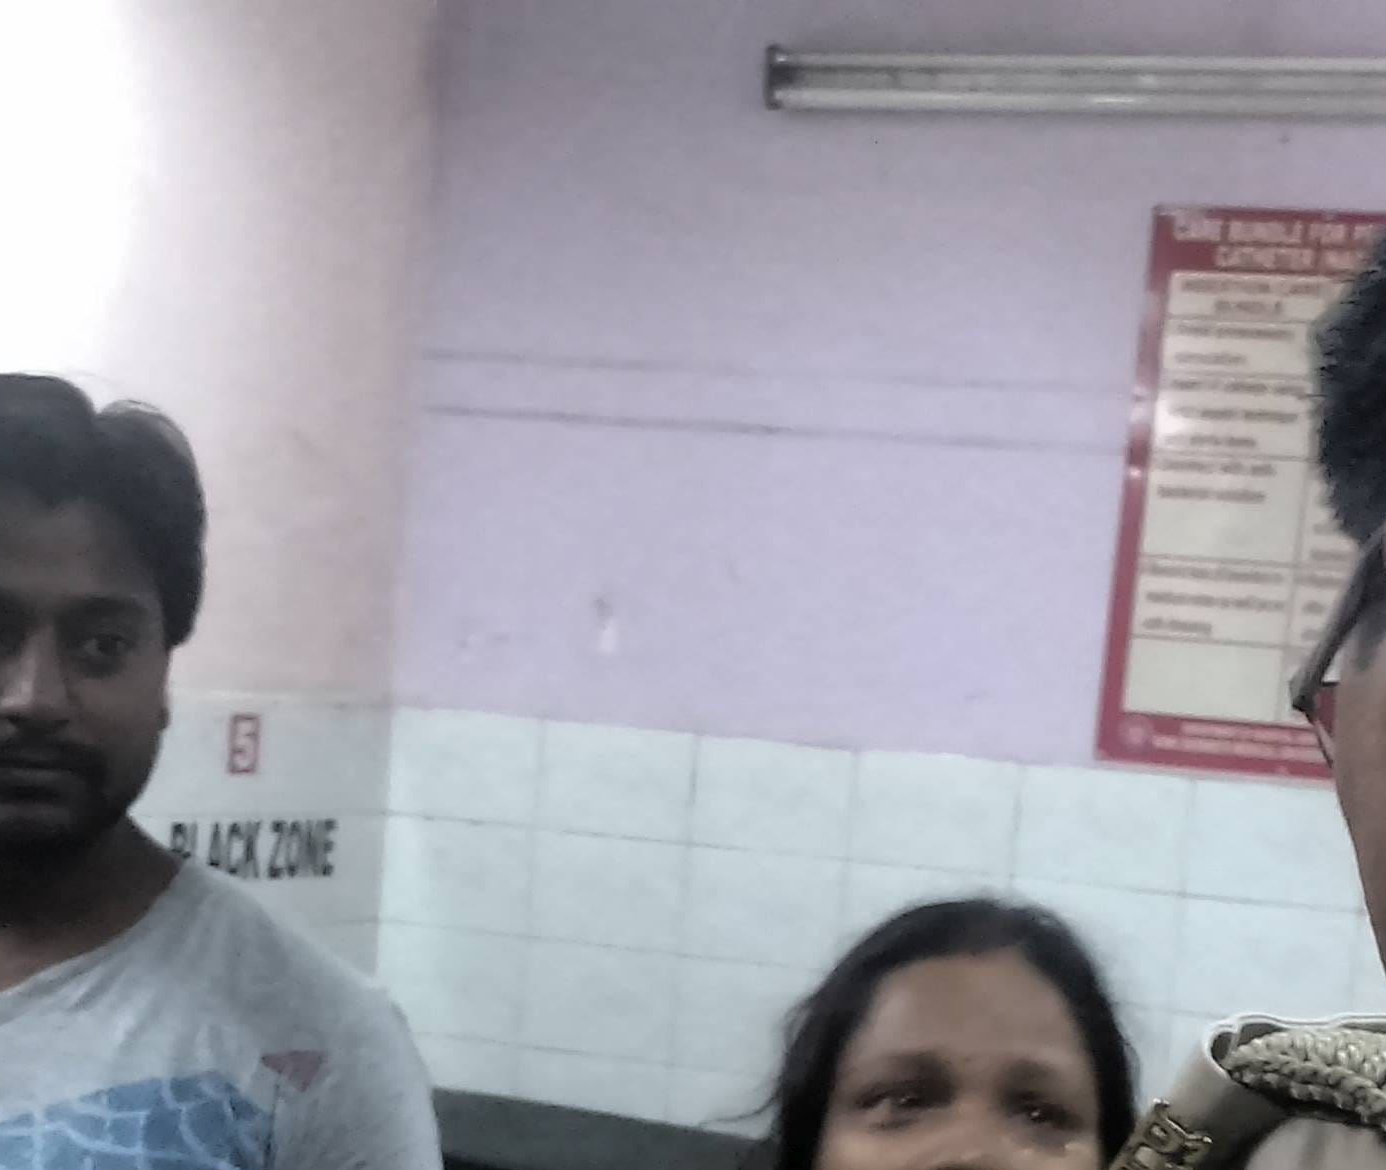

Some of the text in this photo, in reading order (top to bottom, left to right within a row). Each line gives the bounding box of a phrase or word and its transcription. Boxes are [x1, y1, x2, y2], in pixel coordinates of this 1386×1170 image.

[1226, 220, 1302, 243] BUNDLE
[232, 718, 258, 771] 5
[170, 819, 336, 879] BLACK ZONE
